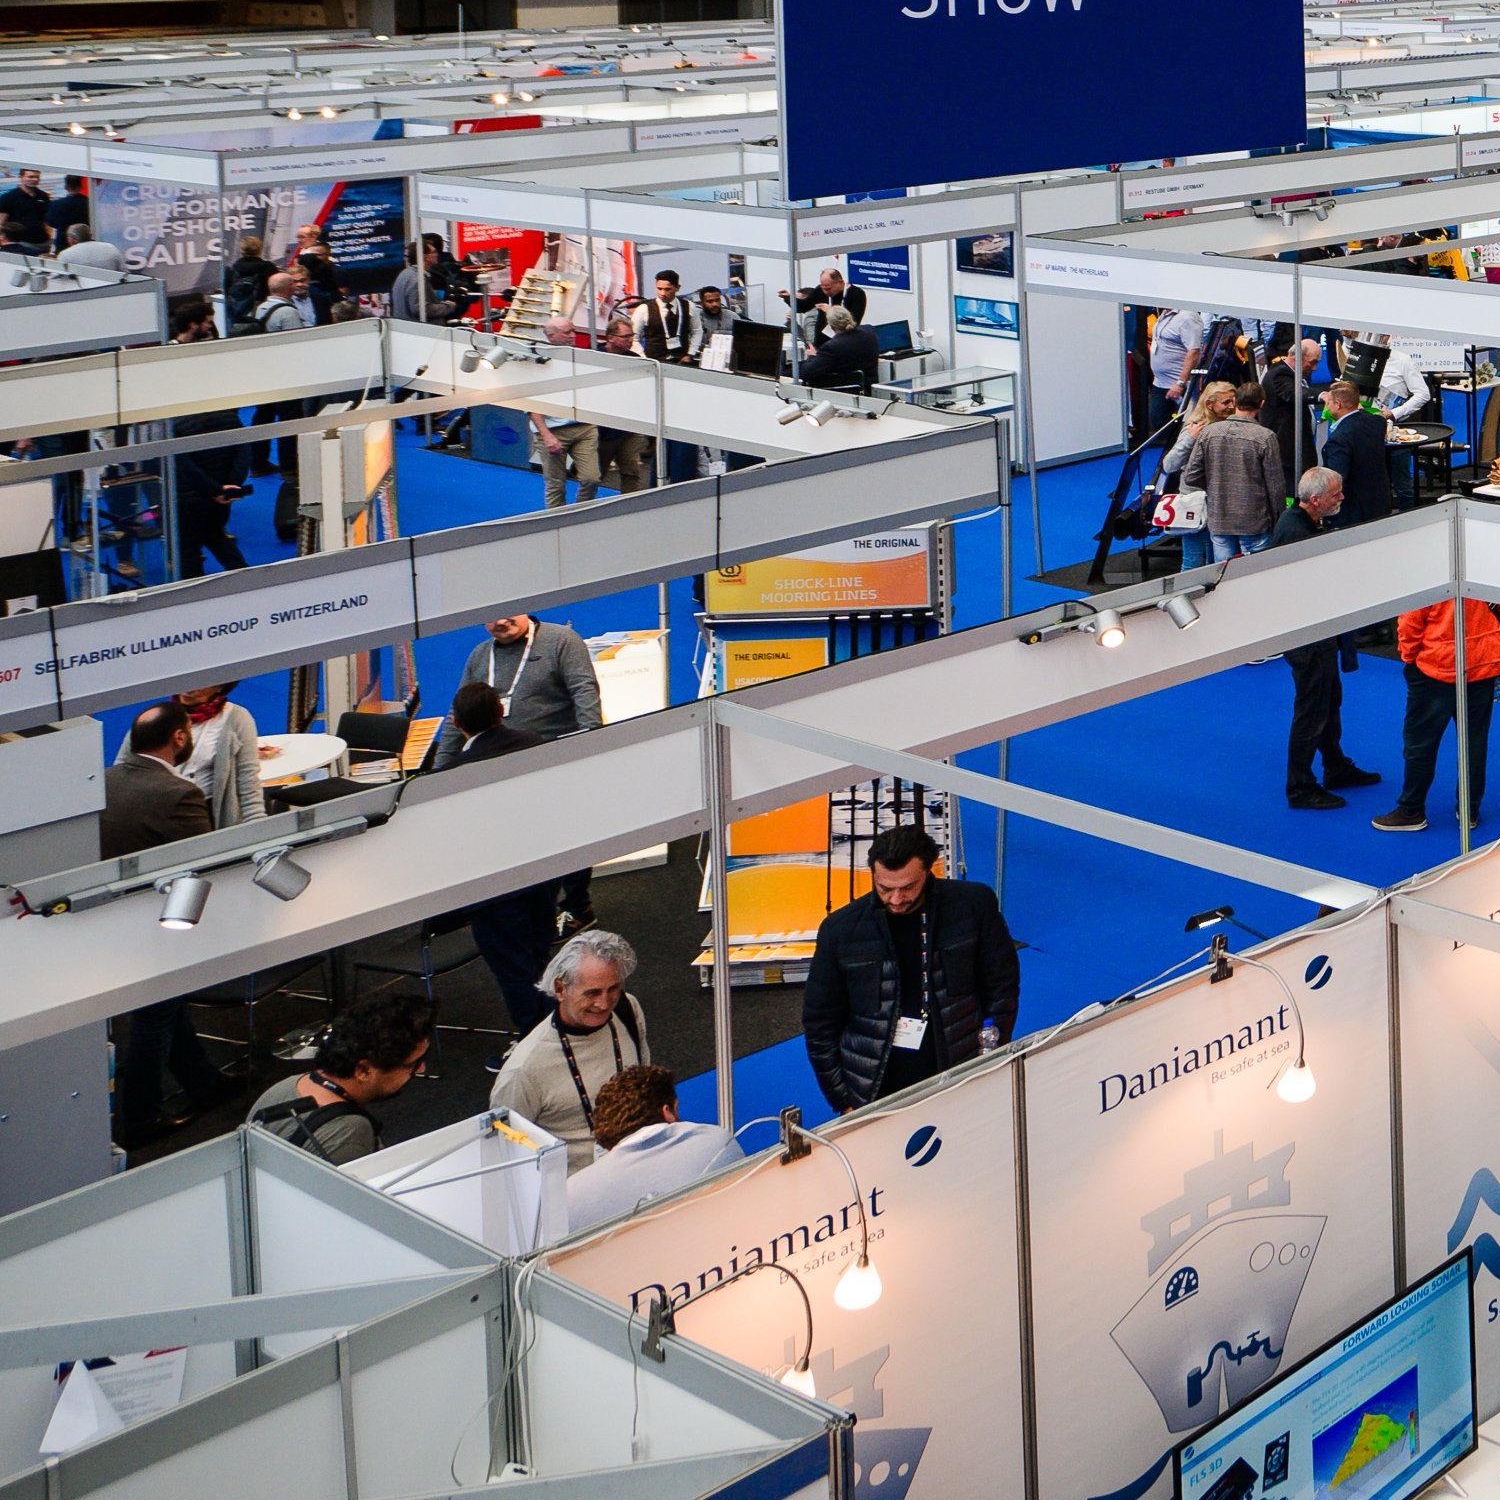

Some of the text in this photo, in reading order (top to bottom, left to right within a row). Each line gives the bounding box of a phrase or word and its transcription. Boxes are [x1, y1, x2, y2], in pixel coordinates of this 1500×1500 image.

[123, 189, 306, 222] PERFORMANCE
[123, 214, 255, 241] OFFSHORE
[123, 239, 229, 268] SAILS
[1154, 495, 1177, 525] 3
[854, 539, 920, 548] THE ORIGINAL
[761, 589, 877, 603] MOORING LINES
[775, 577, 862, 589] SHOCK-LINE
[34, 594, 368, 676] SELFABRIK ULLMANN GROUP SWITZERLAND
[1099, 1003, 1289, 1114] Daniamant
[629, 1185, 885, 1313] Daniamant
[1342, 1263, 1461, 1352] FORWARD LOOKING SONAR
